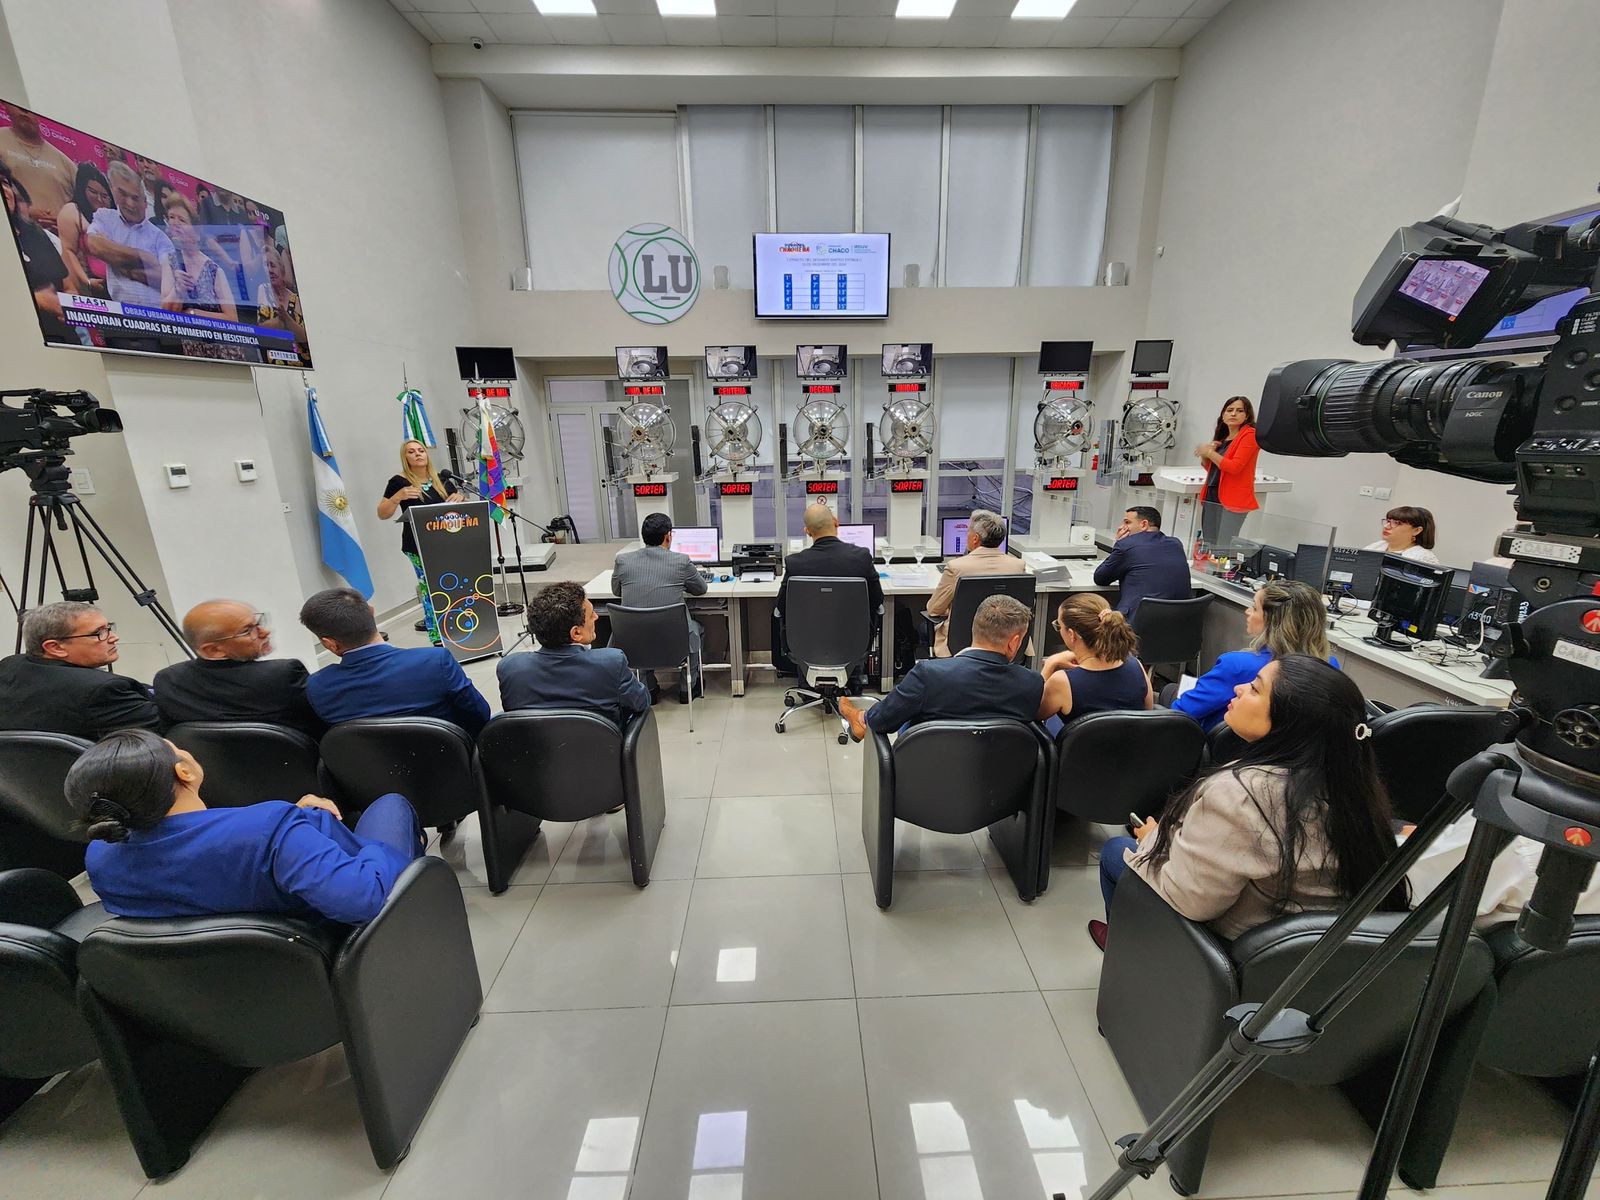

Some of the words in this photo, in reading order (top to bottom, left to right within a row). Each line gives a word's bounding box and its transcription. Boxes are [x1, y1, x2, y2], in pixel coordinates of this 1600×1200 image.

[641, 254, 693, 294] LU
[72, 295, 107, 306] FLASH
[124, 306, 147, 318] OBRAS
[147, 310, 176, 322] URBANAS
[176, 315, 184, 323] EN
[212, 320, 227, 330] VILLA
[66, 310, 122, 327] INAUGURAN
[122, 319, 161, 332] CUADRAS
[161, 324, 173, 335] DE
[173, 326, 213, 339] PAVIMENTO
[213, 331, 223, 340] EN
[223, 332, 260, 345] RESISTENCIA
[718, 387, 747, 396] CENTENA
[809, 385, 834, 394] DECENA
[895, 383, 919, 392] UNIDAD
[1466, 391, 1504, 399] Canon
[635, 485, 664, 495] SORTEA
[721, 484, 750, 494] SORTEA
[807, 482, 837, 492] SORTEA
[894, 481, 922, 491] SORTEA
